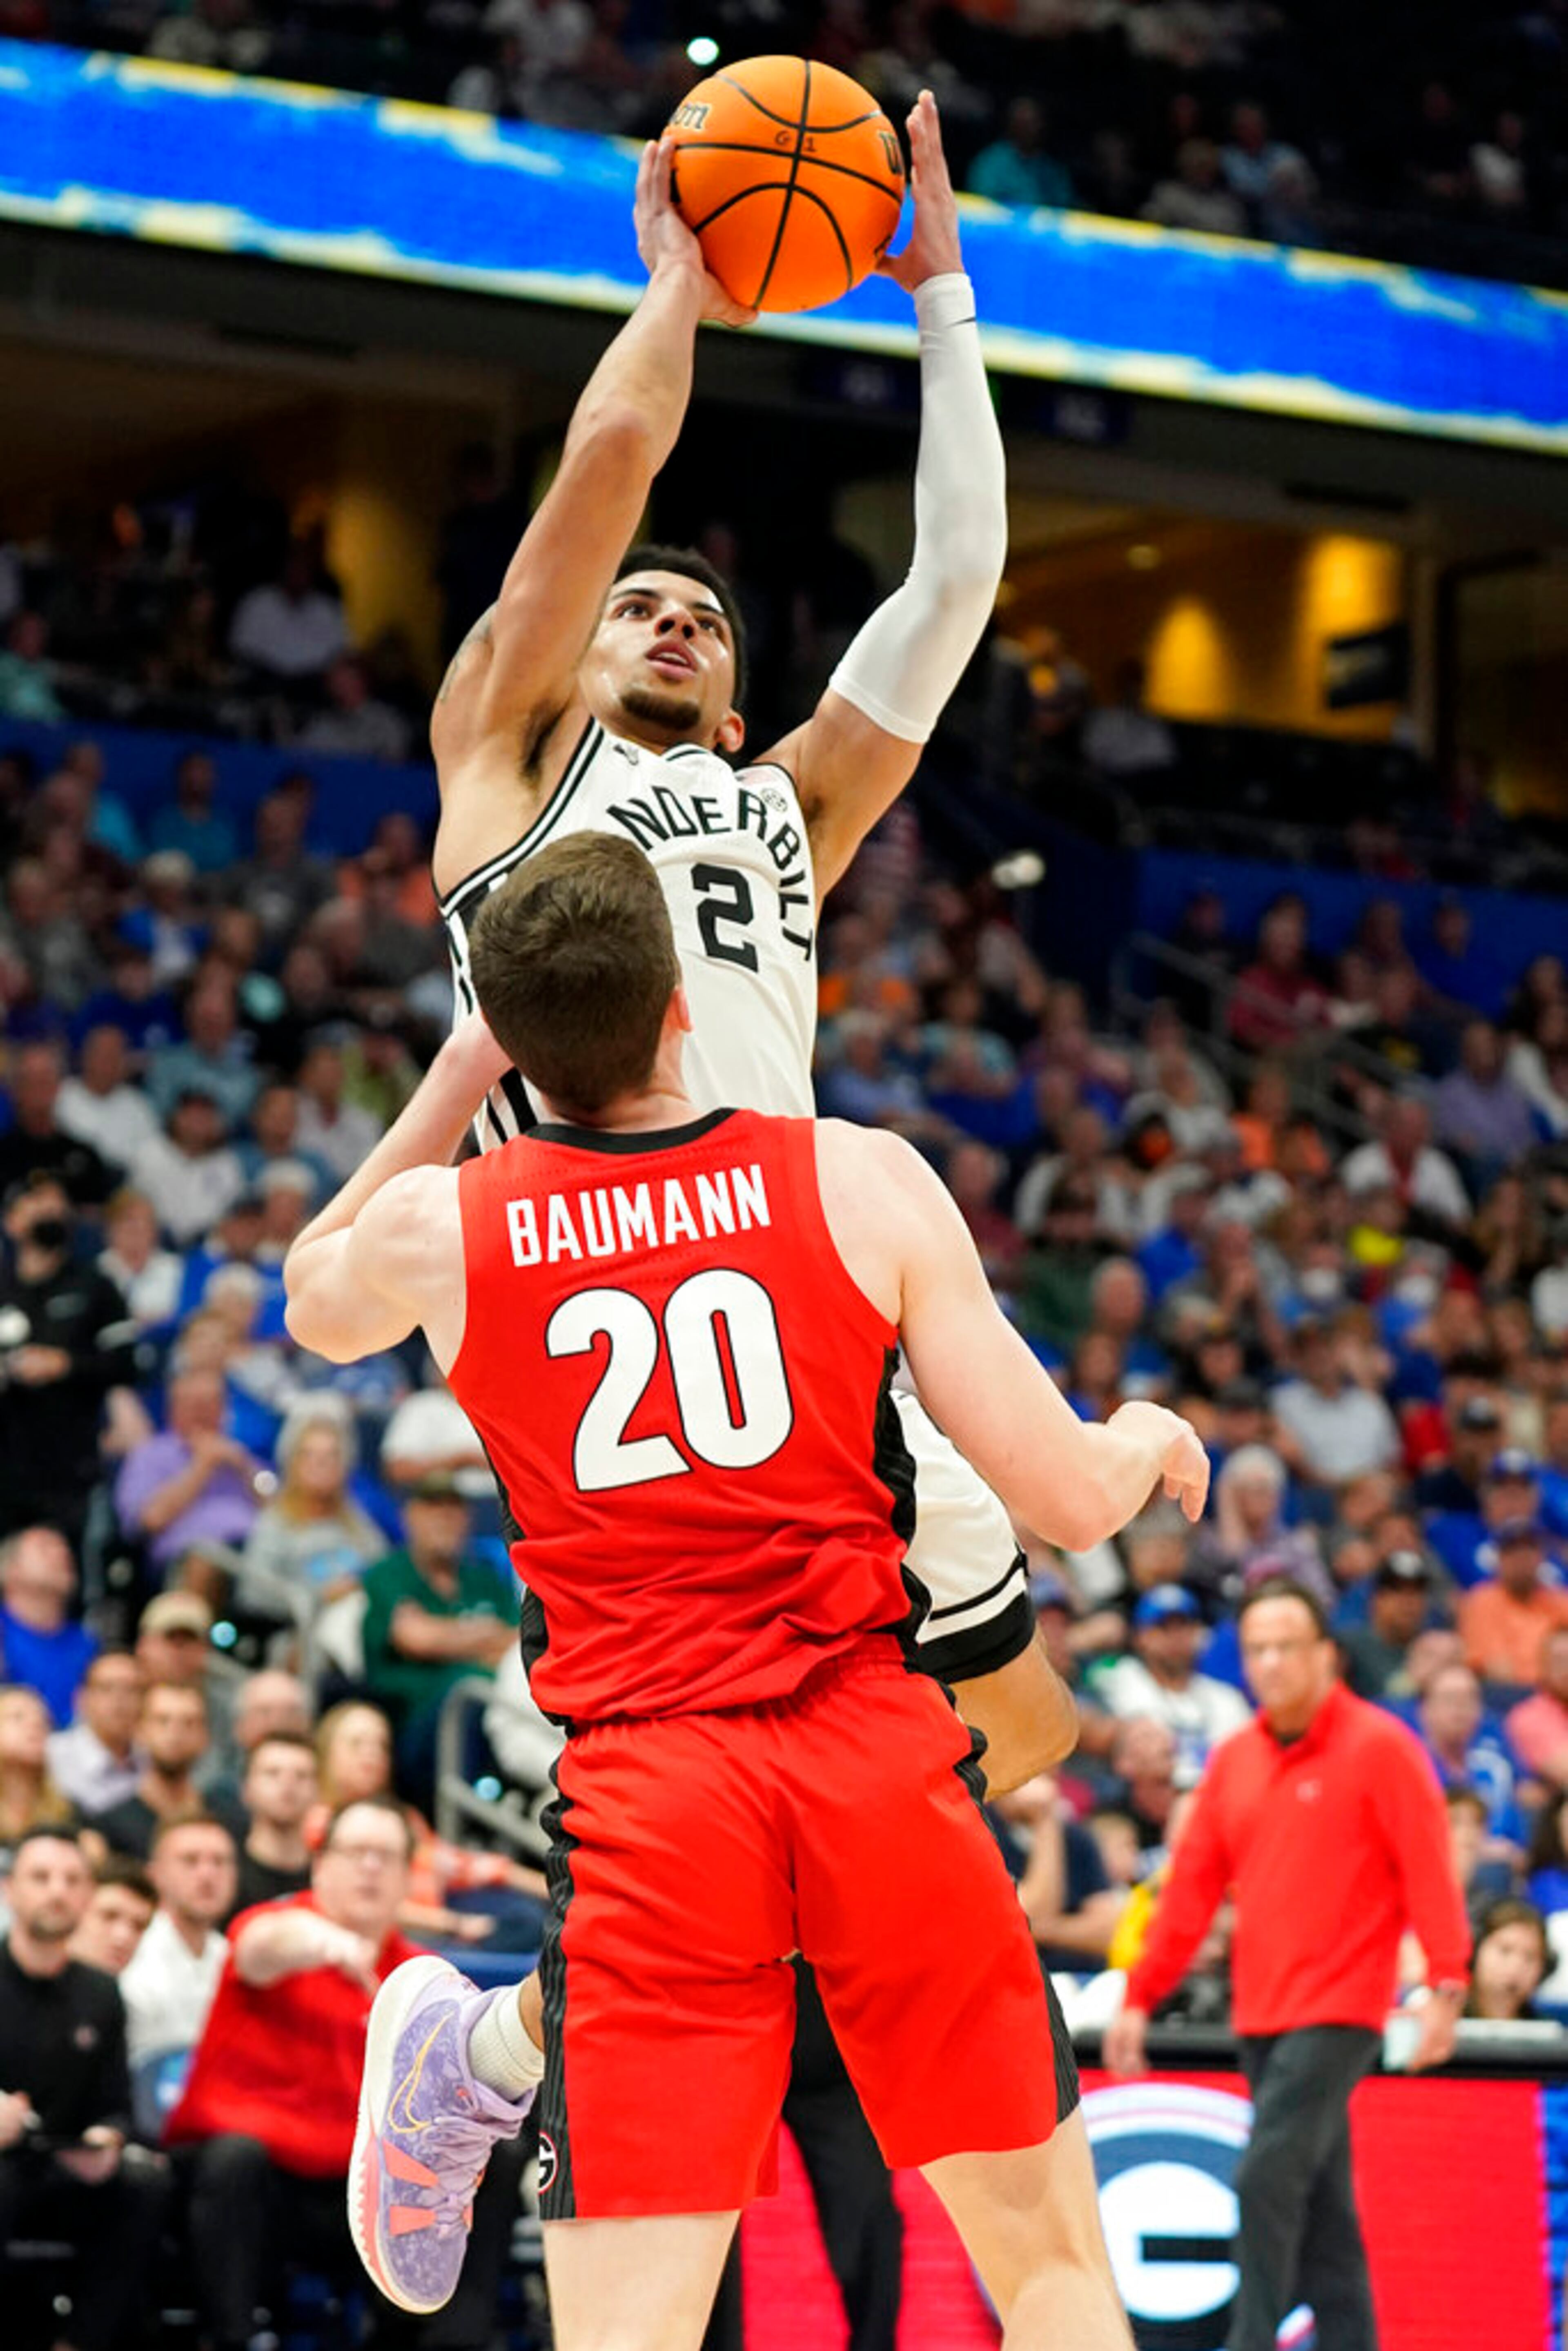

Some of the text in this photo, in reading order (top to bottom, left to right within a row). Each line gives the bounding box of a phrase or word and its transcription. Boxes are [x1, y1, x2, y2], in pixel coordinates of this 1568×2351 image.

[606, 785, 813, 961] NDERBILT
[690, 862, 759, 973] 2
[506, 1164, 771, 1267] BAUMANN
[545, 1267, 795, 1492] 20
